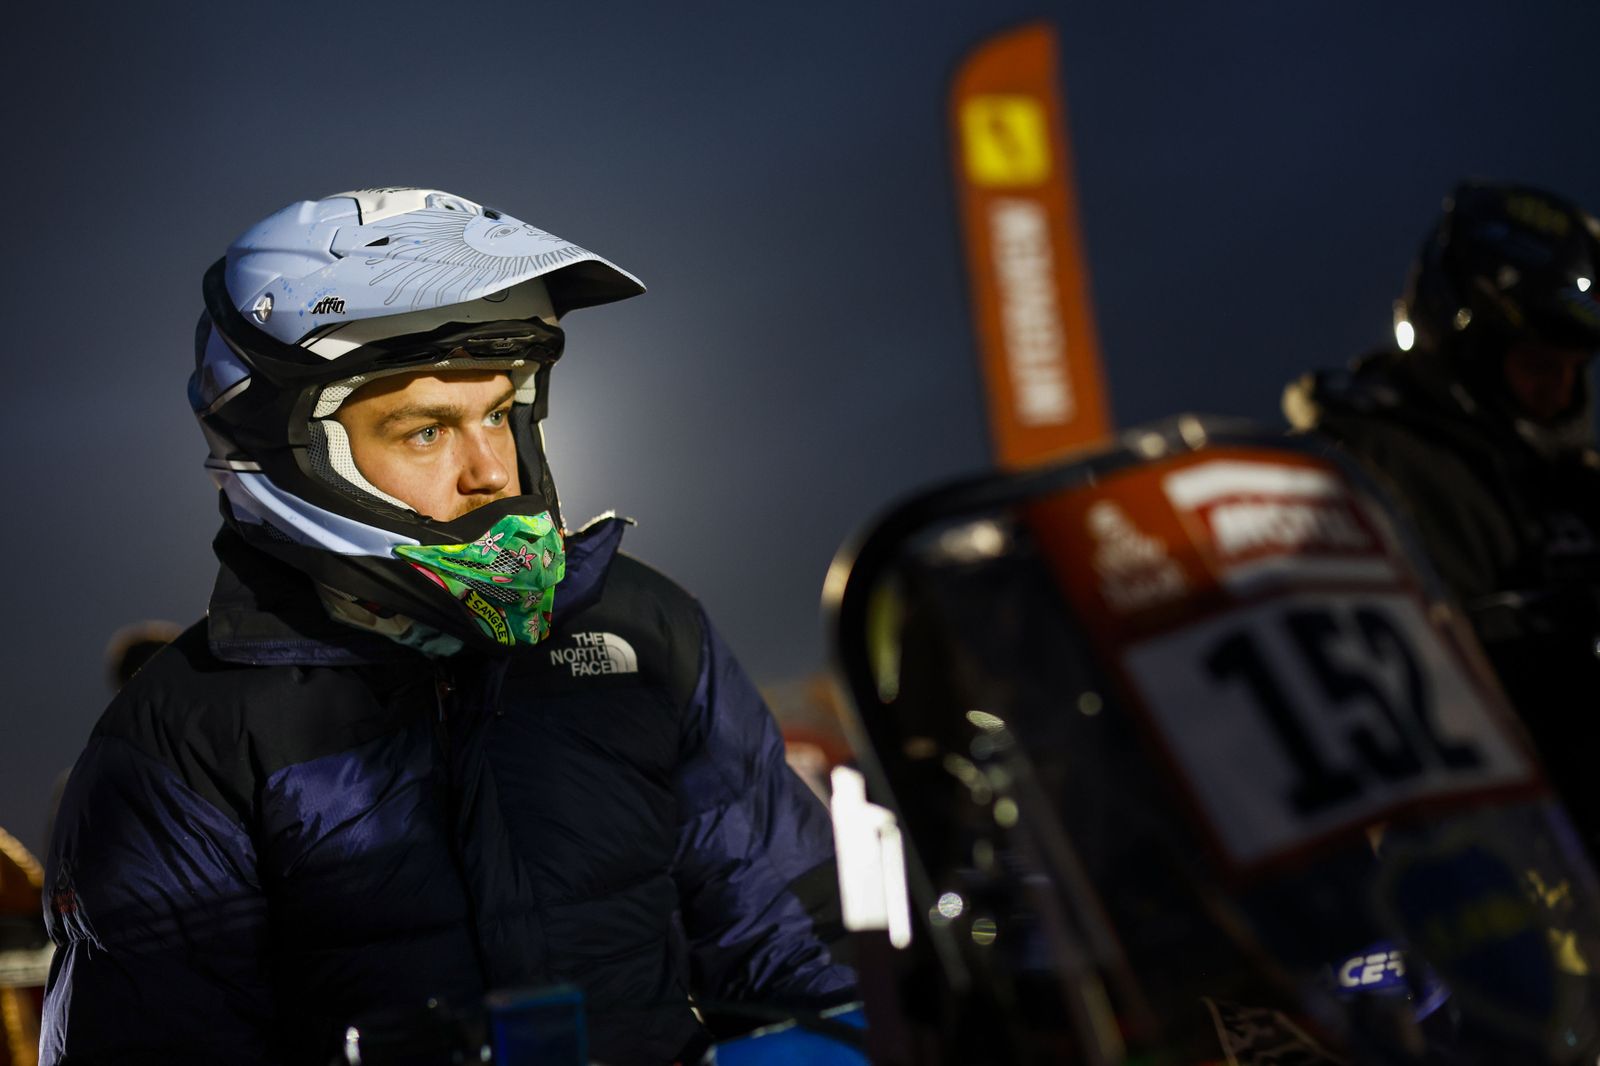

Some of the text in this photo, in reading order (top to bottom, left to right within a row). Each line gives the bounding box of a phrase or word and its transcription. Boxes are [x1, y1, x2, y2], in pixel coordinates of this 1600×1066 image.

[472, 600, 506, 639] SANGRE
[572, 632, 605, 647] THE
[551, 645, 609, 666] NORTH
[571, 659, 612, 677] FACE
[1206, 609, 1482, 813] 152
